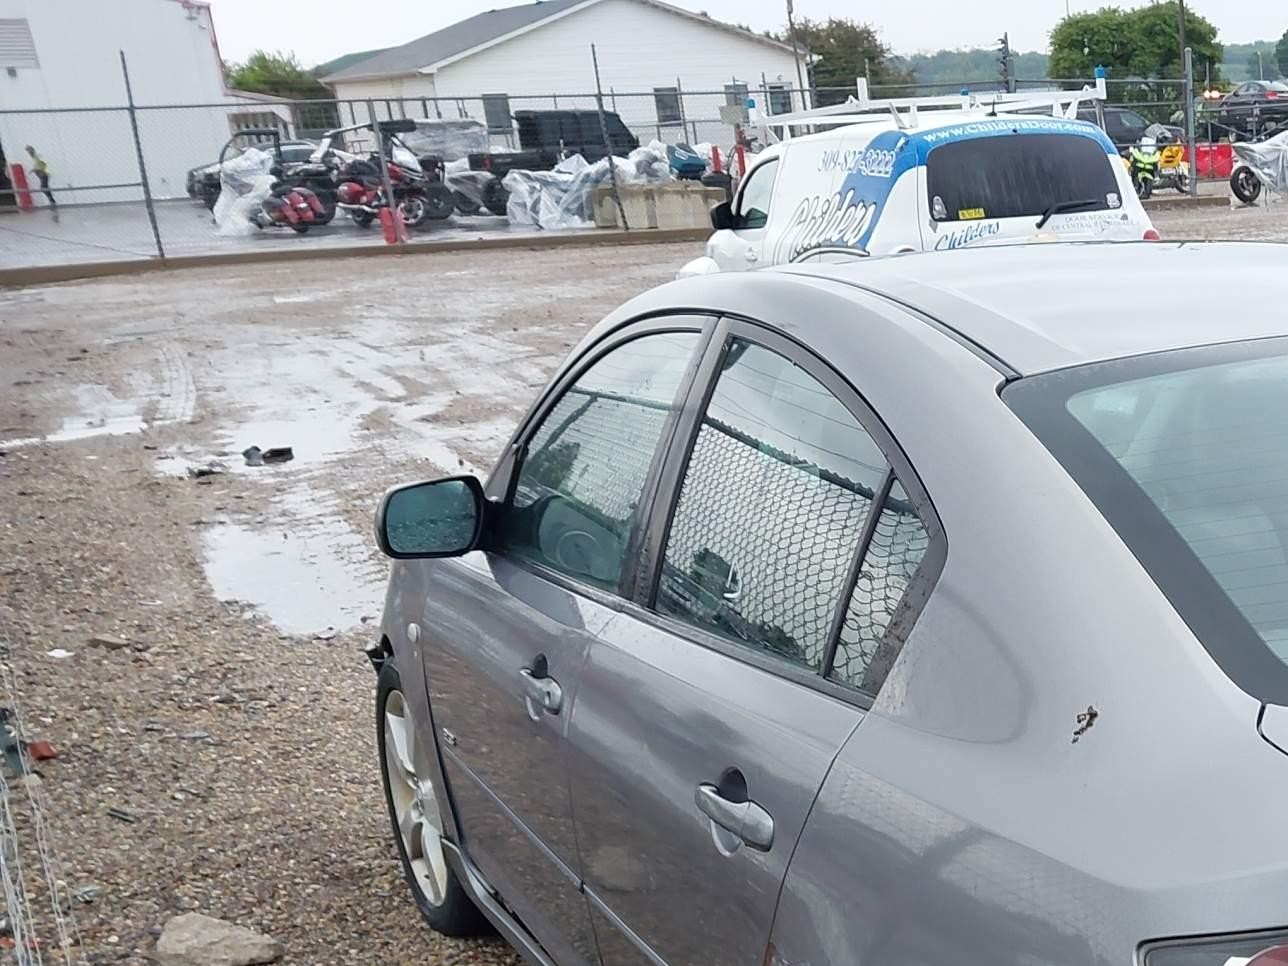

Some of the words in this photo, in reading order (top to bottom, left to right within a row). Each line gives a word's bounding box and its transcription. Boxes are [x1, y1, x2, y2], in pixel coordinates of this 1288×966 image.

[923, 120, 1096, 143] www.ChildersDoor.com
[786, 188, 878, 262] Childers
[935, 222, 1001, 251] Childers
